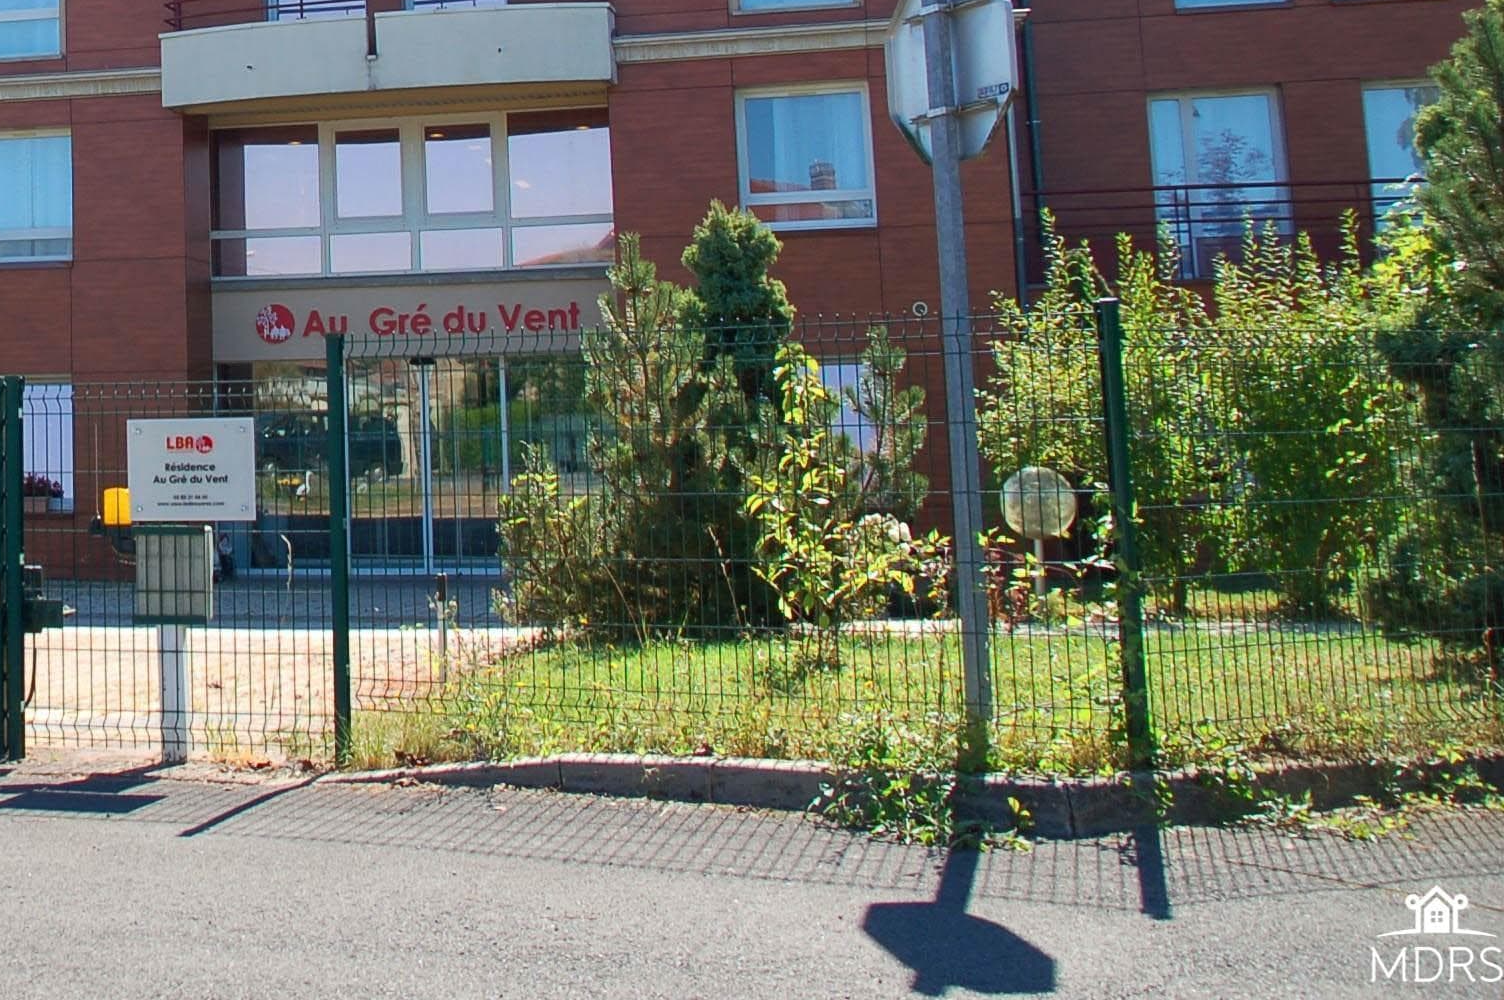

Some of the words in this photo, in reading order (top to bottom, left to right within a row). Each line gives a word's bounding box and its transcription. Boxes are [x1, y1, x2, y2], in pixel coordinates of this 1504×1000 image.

[302, 309, 348, 337] Au
[369, 303, 432, 335] Gré
[442, 305, 486, 333] du
[497, 302, 581, 332] Vent
[166, 436, 194, 450] LBA
[165, 463, 216, 472] Résidence
[153, 475, 167, 484] Au
[169, 474, 188, 484] Gré
[189, 475, 202, 484] du
[205, 475, 229, 483] Vent
